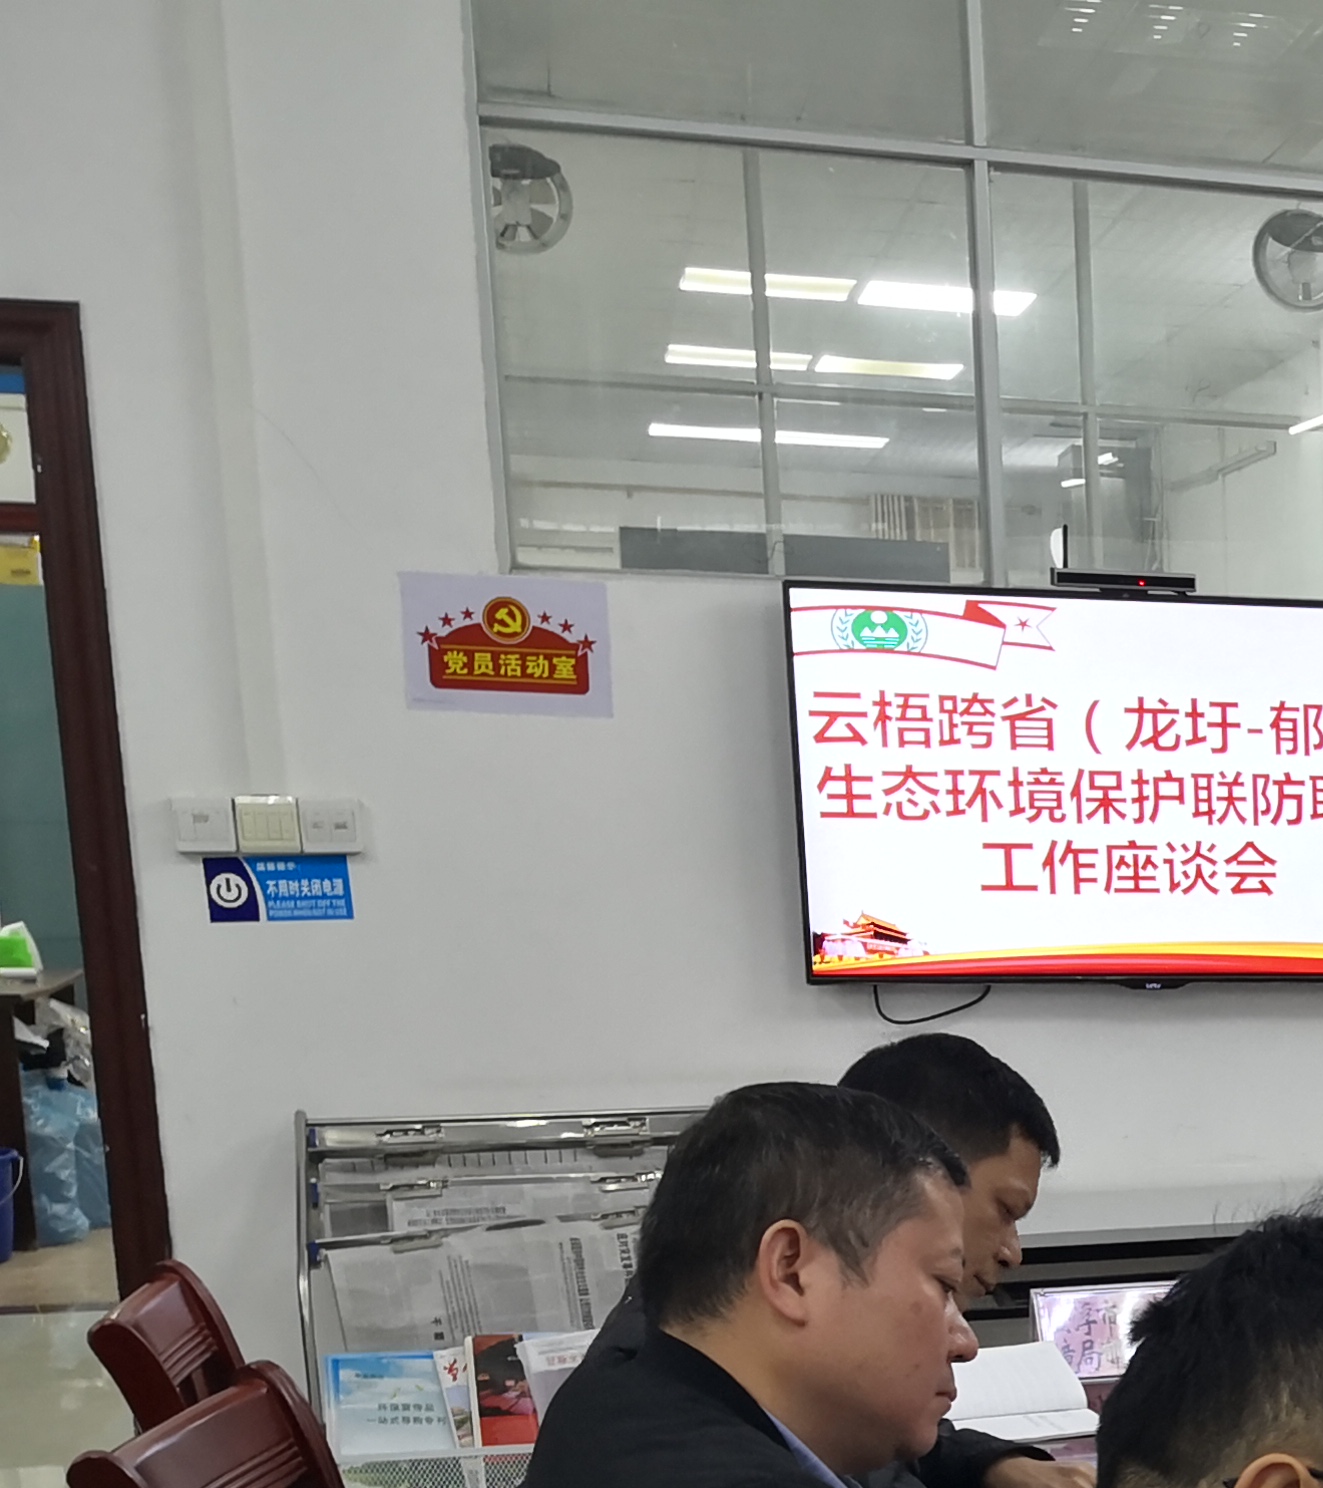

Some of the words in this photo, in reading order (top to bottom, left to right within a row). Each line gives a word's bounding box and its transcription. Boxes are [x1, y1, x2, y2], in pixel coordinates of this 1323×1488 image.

[443, 651, 577, 679] 党员活动室
[981, 840, 1279, 896] 工作座谈会
[266, 878, 345, 898] 不用时关闭电源
